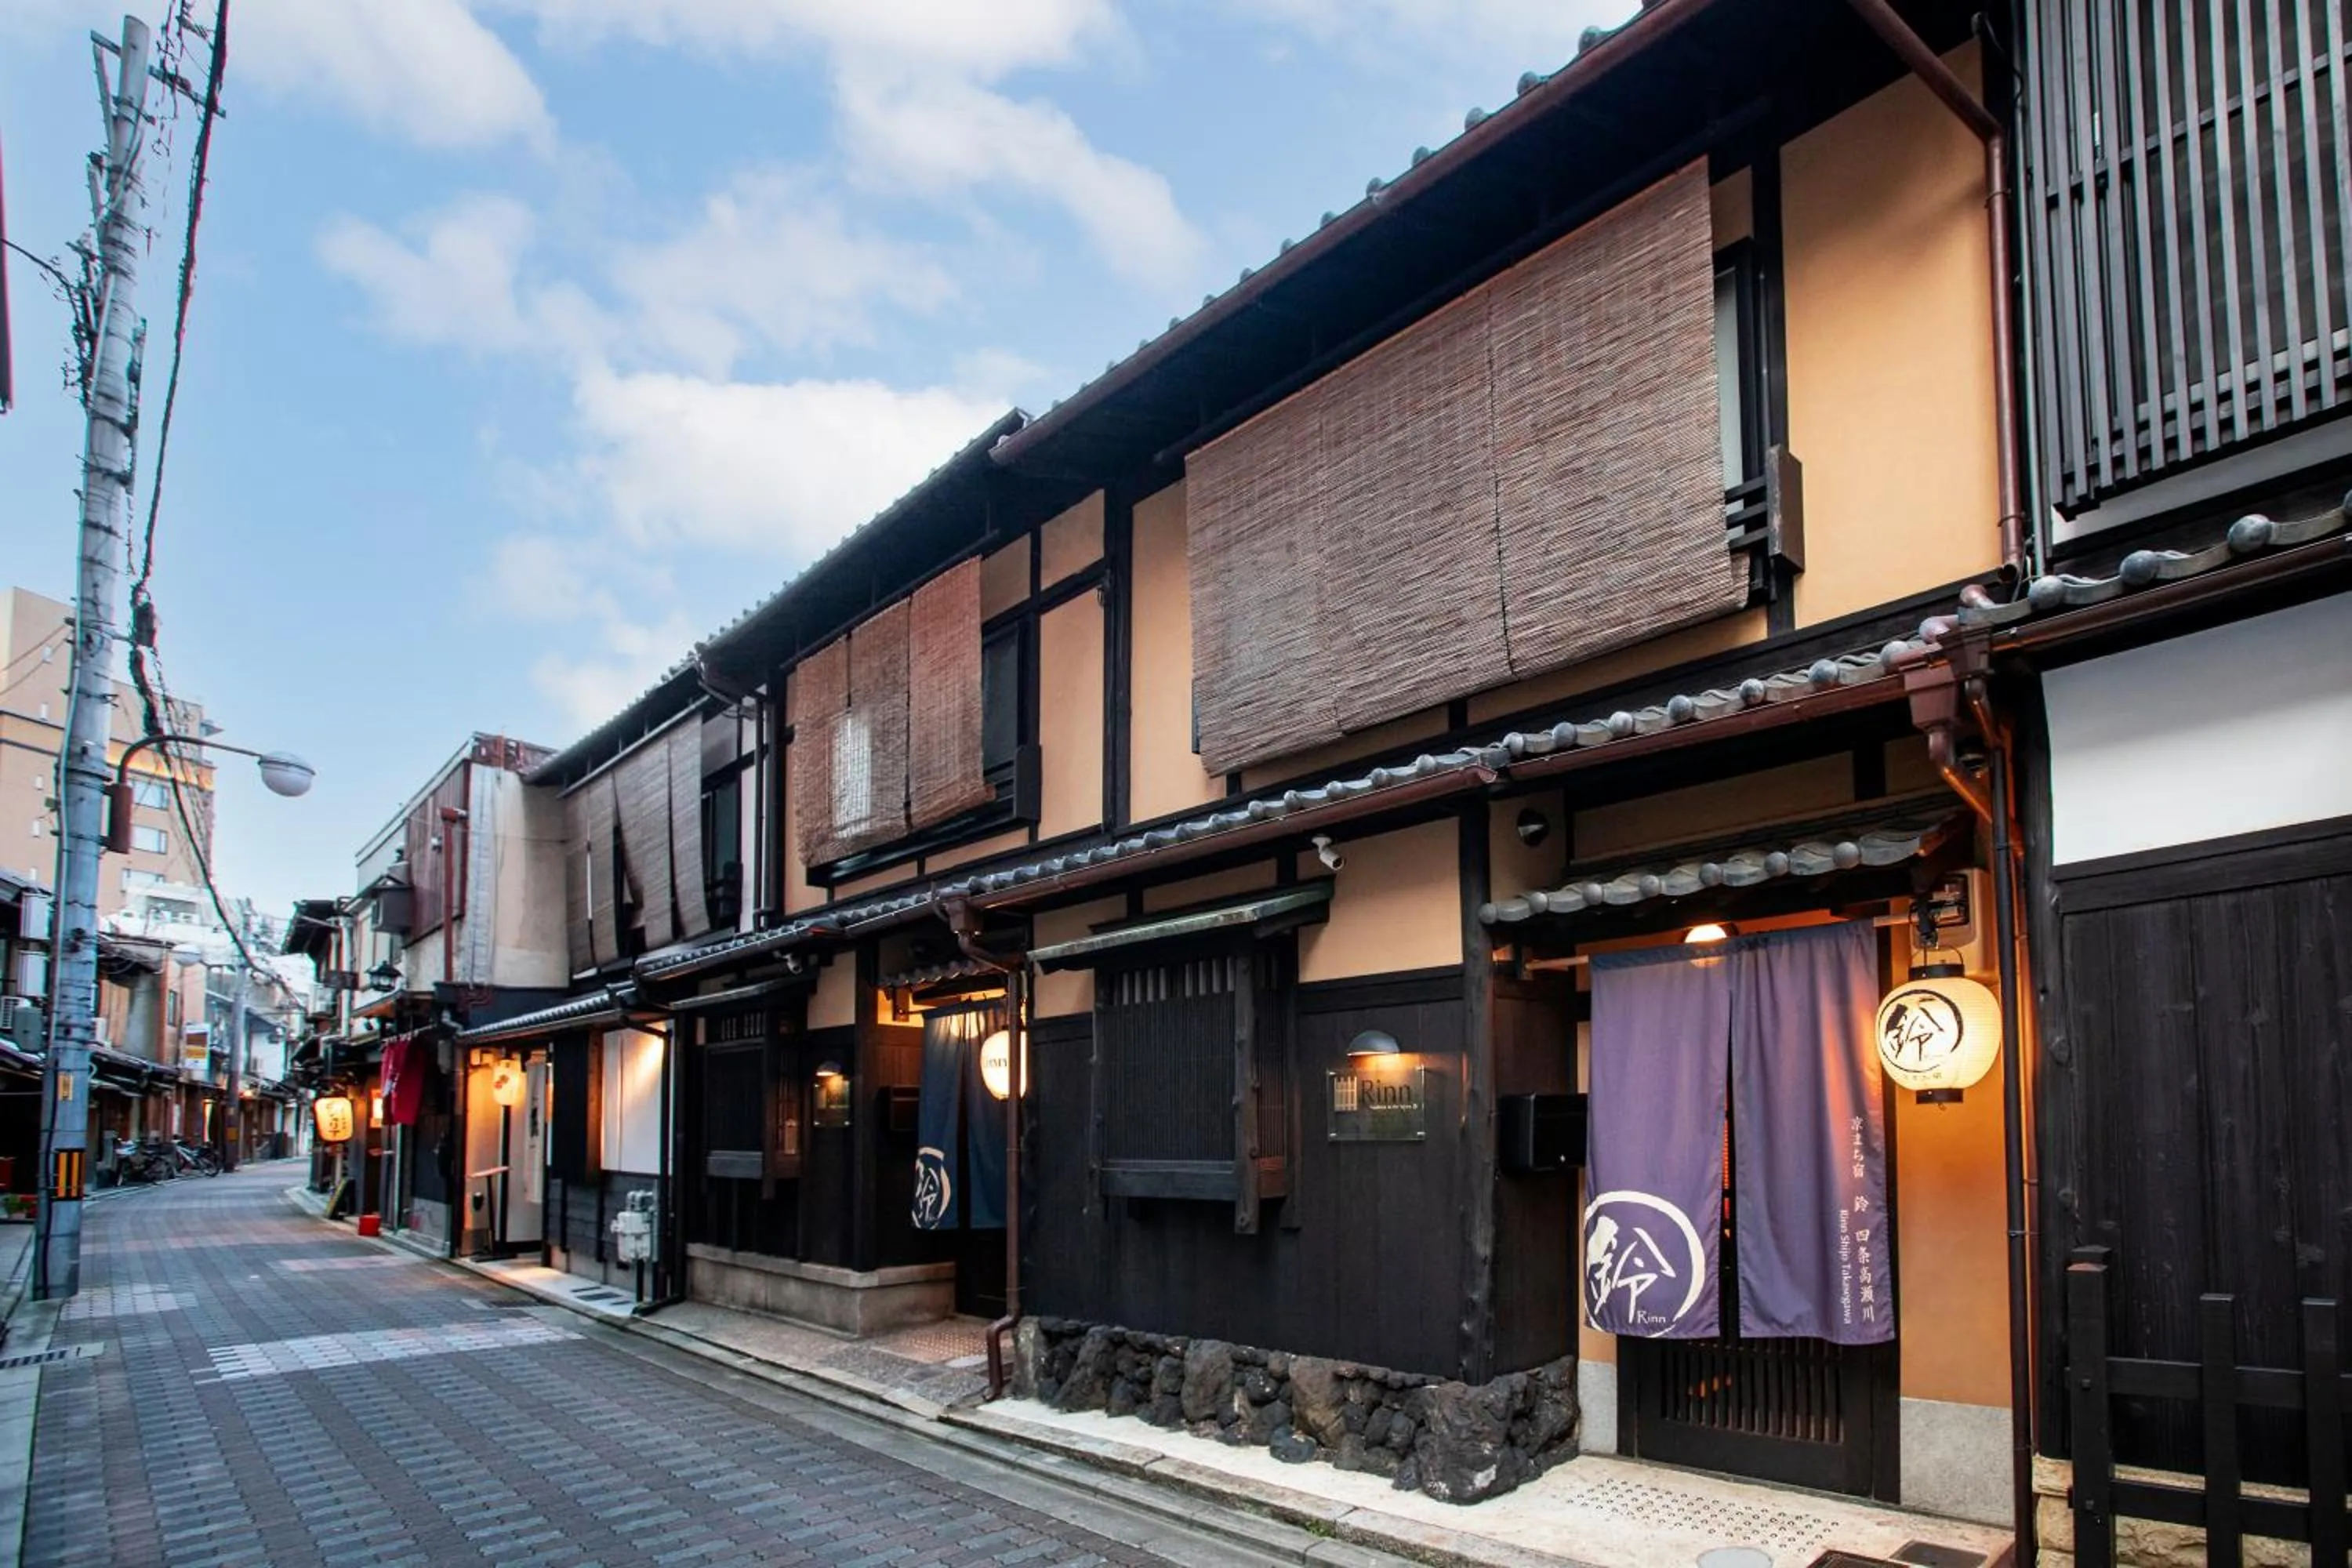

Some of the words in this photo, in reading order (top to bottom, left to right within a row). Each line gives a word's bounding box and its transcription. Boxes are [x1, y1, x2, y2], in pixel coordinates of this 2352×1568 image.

[1361, 1079, 1411, 1105] Rinn
[1839, 1236, 1851, 1261] Shijo
[1855, 1229, 1875, 1323] 四条高瀬川
[1636, 1310, 1667, 1324] Rinn
